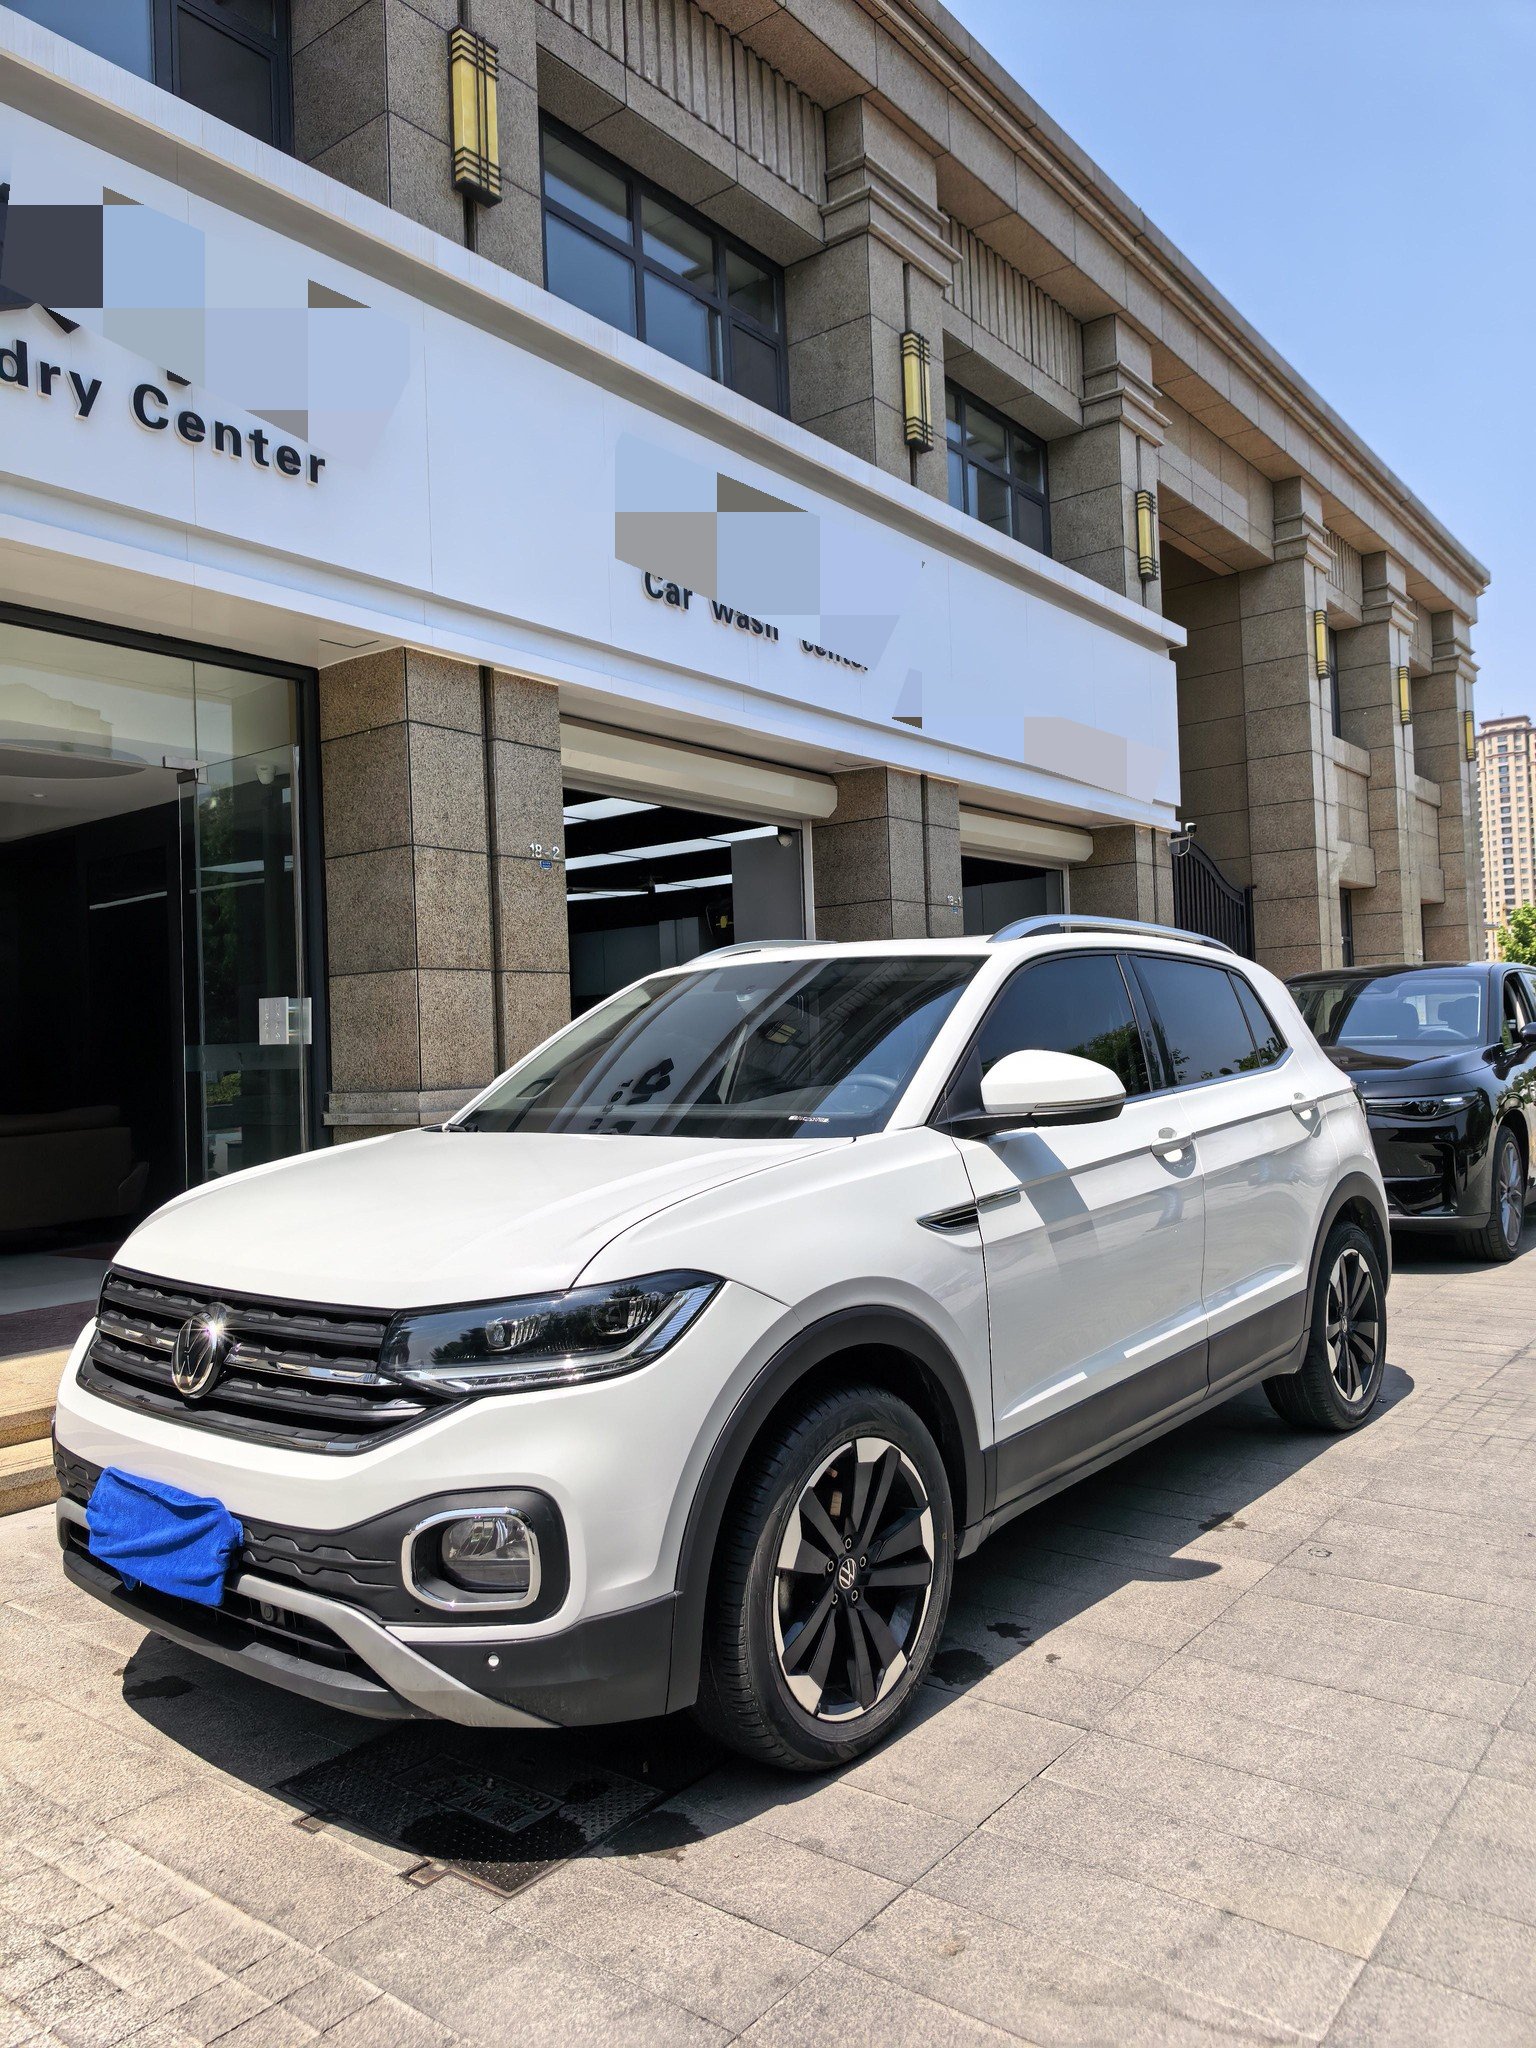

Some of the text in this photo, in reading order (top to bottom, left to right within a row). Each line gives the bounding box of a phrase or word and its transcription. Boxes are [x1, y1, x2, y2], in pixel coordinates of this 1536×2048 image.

[0, 339, 326, 486] dry Center
[643, 571, 693, 610] Car
